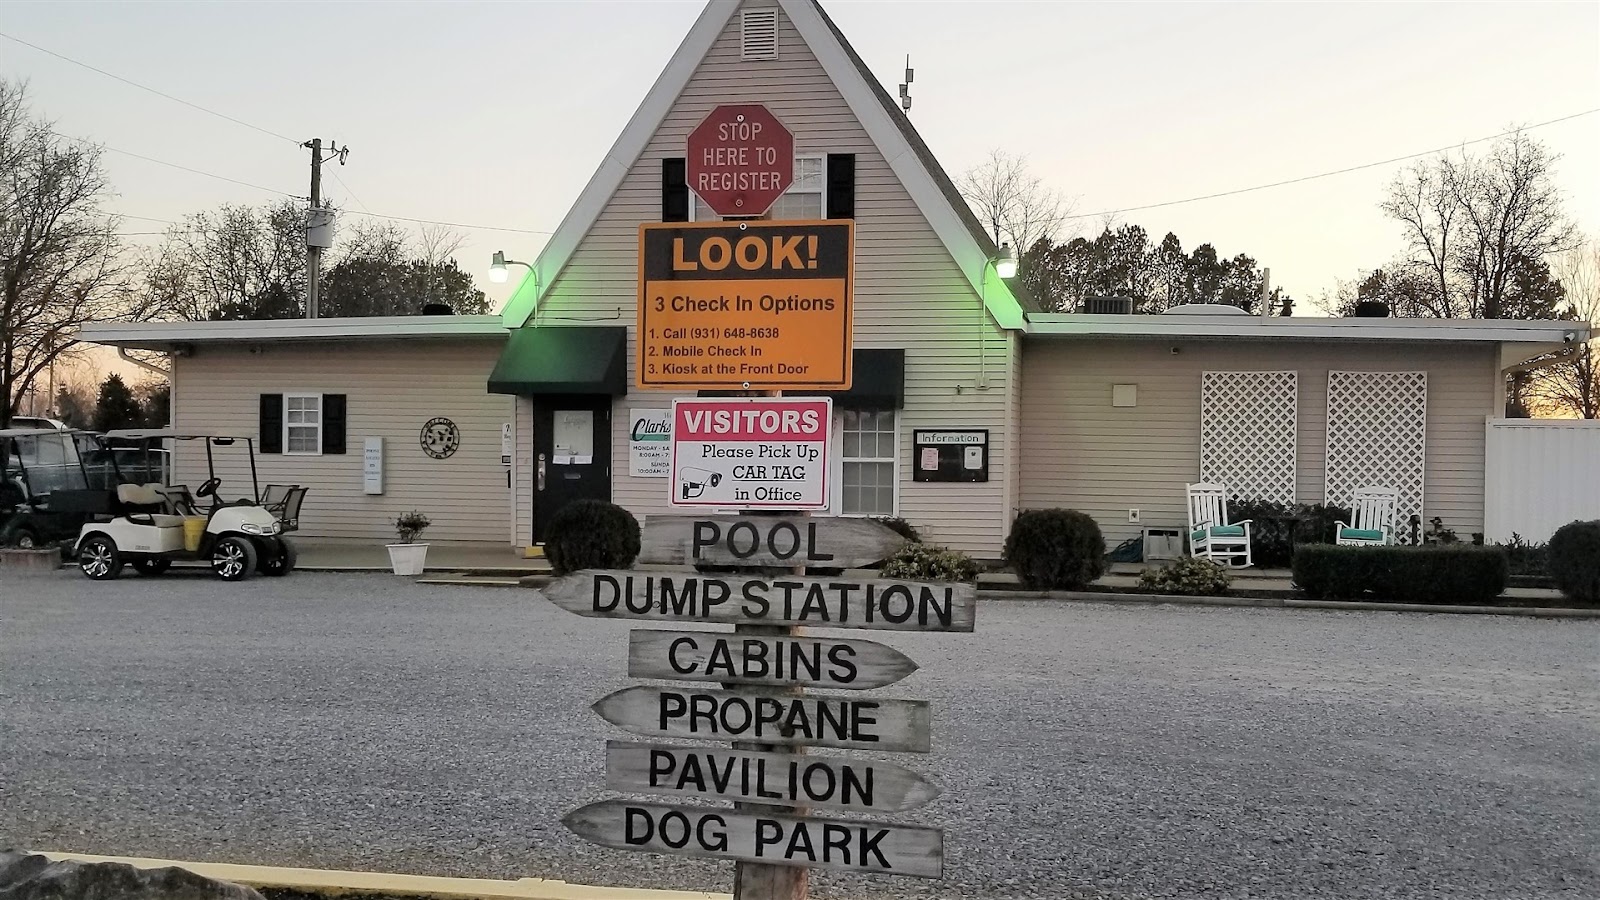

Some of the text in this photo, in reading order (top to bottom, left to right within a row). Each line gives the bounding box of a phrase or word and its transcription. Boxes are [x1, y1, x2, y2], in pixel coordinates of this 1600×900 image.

[718, 122, 762, 141] STOP
[703, 147, 777, 166] HERE TO
[699, 172, 781, 190] REGISTER
[673, 235, 819, 271] LOOK!
[655, 294, 835, 315] 3 Check In Options
[649, 328, 779, 340] 1. Call (931) 648-8638
[648, 346, 762, 357] 2. Mobile Check In
[648, 364, 809, 374] 3. Kiosk at the Front Door
[683, 410, 819, 434] VISITORS
[922, 433, 979, 442] Information
[702, 444, 819, 461] Please Pick Up
[732, 466, 806, 480] CAR TAG
[735, 487, 802, 500] in Office
[693, 520, 834, 561] POOL
[592, 574, 952, 627] DUMP STATION
[668, 637, 857, 684] CABINS
[659, 692, 880, 742] PROPANE
[649, 750, 873, 806] PAVILION
[625, 807, 892, 868] DOG PARK
